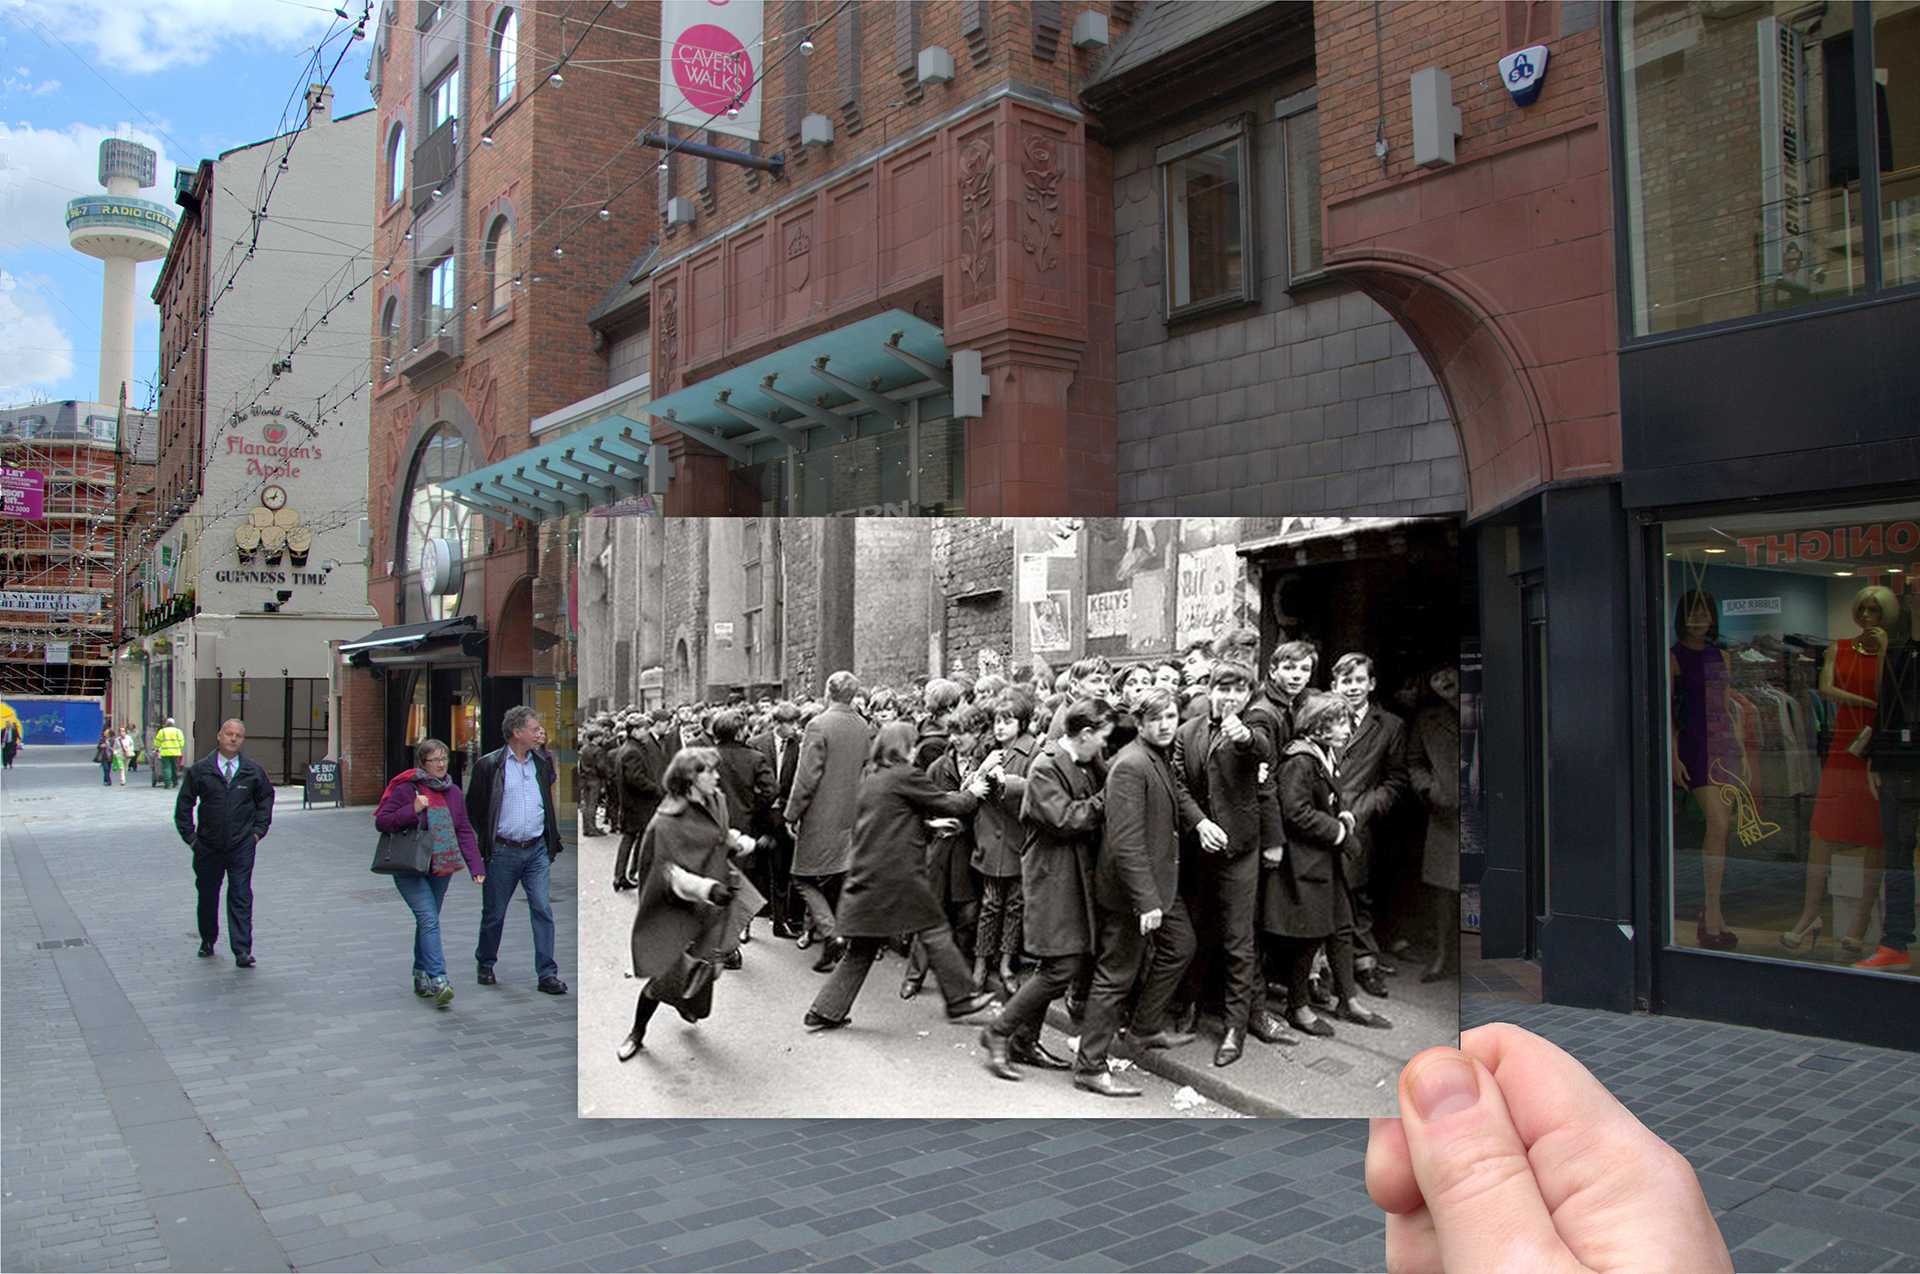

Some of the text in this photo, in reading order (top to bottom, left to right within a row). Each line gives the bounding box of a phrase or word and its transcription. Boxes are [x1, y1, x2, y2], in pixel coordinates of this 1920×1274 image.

[678, 45, 747, 77] CAVERN
[684, 64, 743, 94] WALKS
[102, 205, 132, 217] RADIO
[135, 211, 158, 223] CITY
[250, 405, 283, 417] World
[226, 435, 322, 462] Flanagan's
[6, 469, 26, 477] LET
[246, 458, 301, 481] Apple
[215, 569, 327, 586] GUINNESS TIME
[309, 764, 336, 773] WE BUY
[316, 773, 334, 782] GOLD
